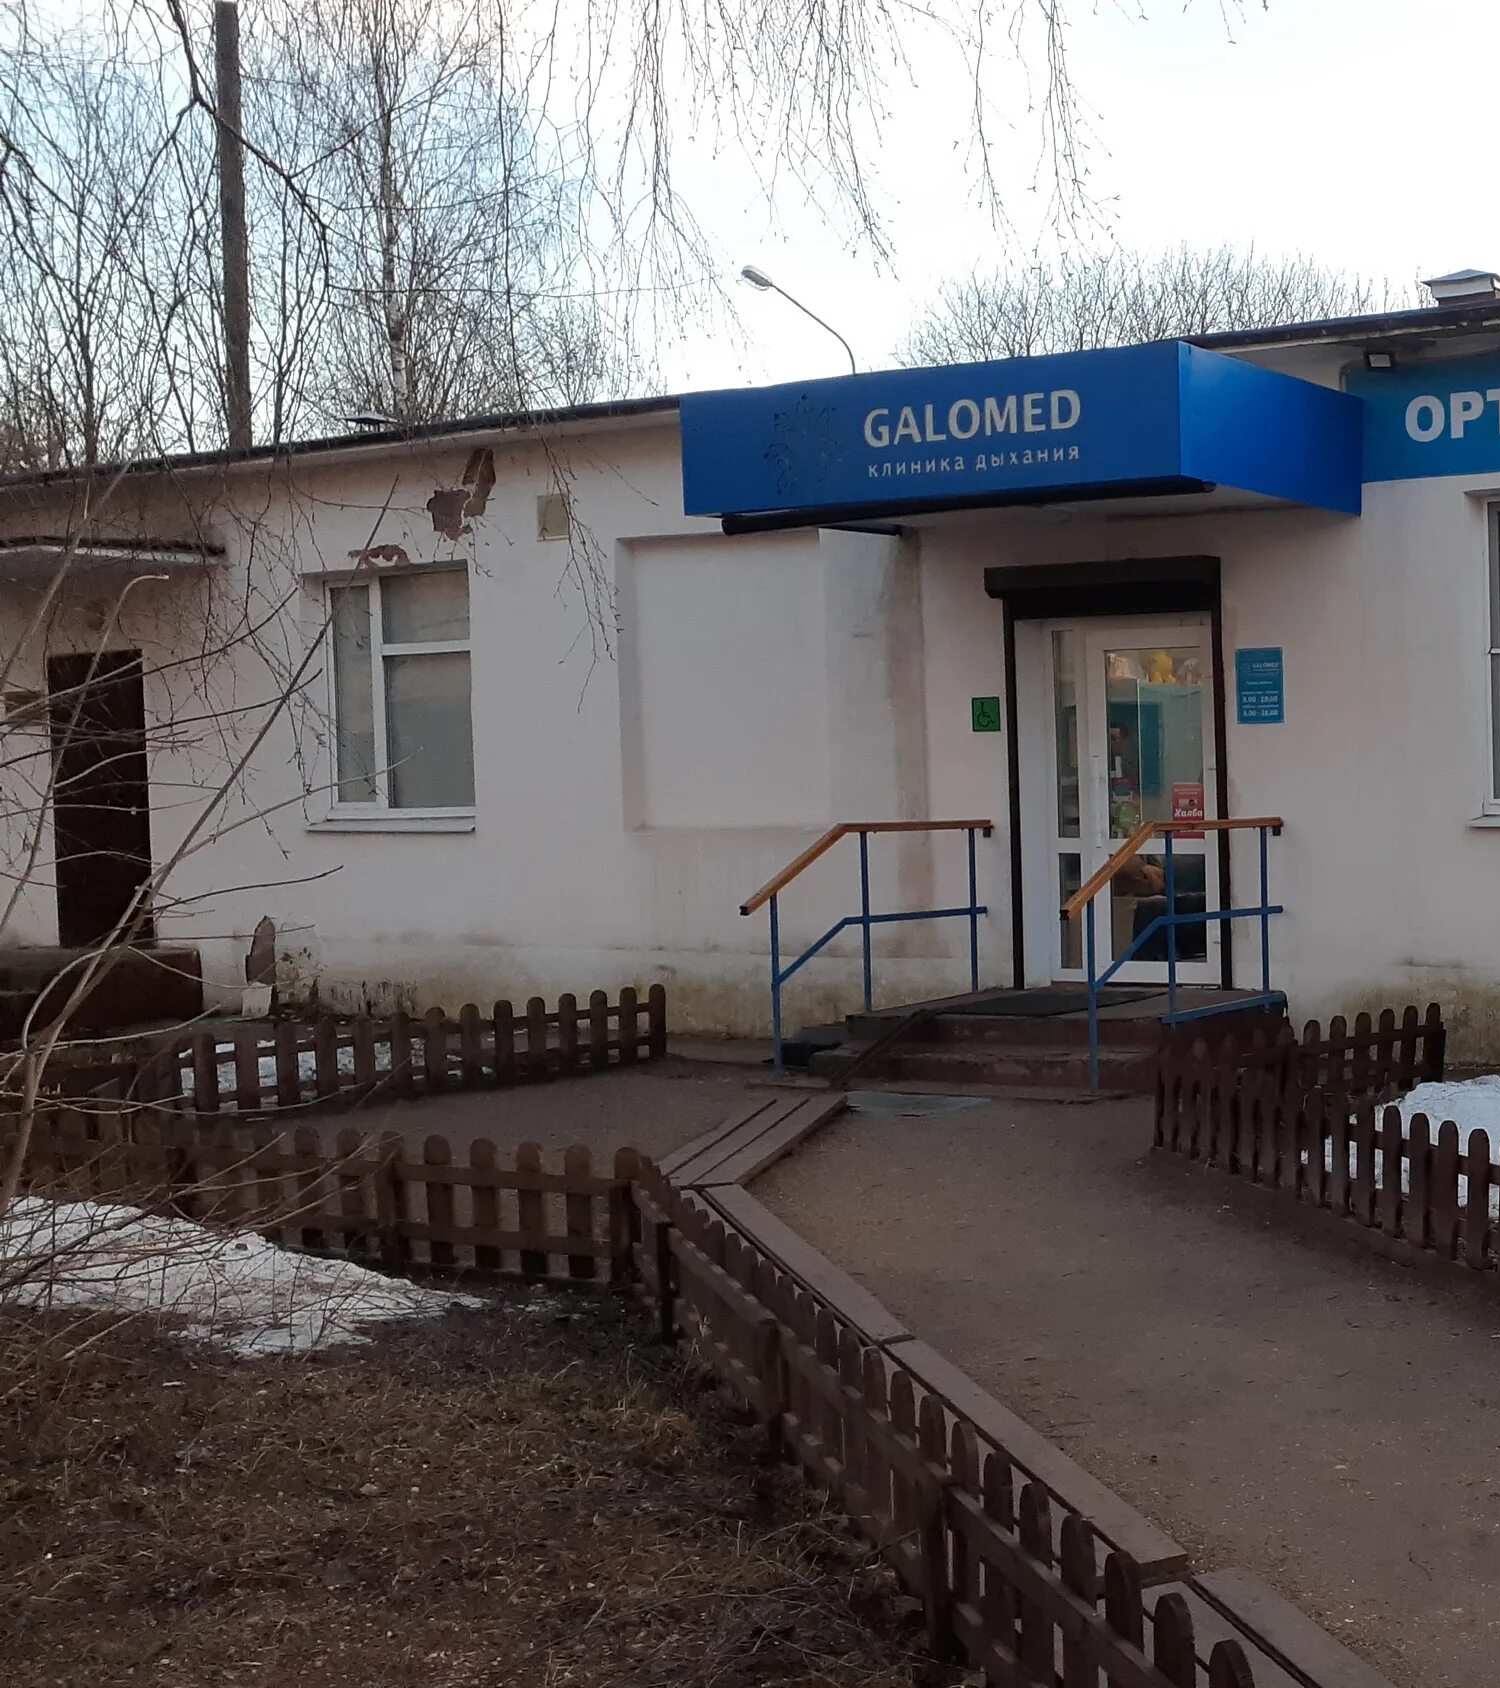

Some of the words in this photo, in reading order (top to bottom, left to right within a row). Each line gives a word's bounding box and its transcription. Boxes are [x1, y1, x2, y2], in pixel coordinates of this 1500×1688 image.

[864, 389, 1081, 448] GALOMED
[868, 456, 965, 478] клиника
[975, 445, 1080, 472] дыхания
